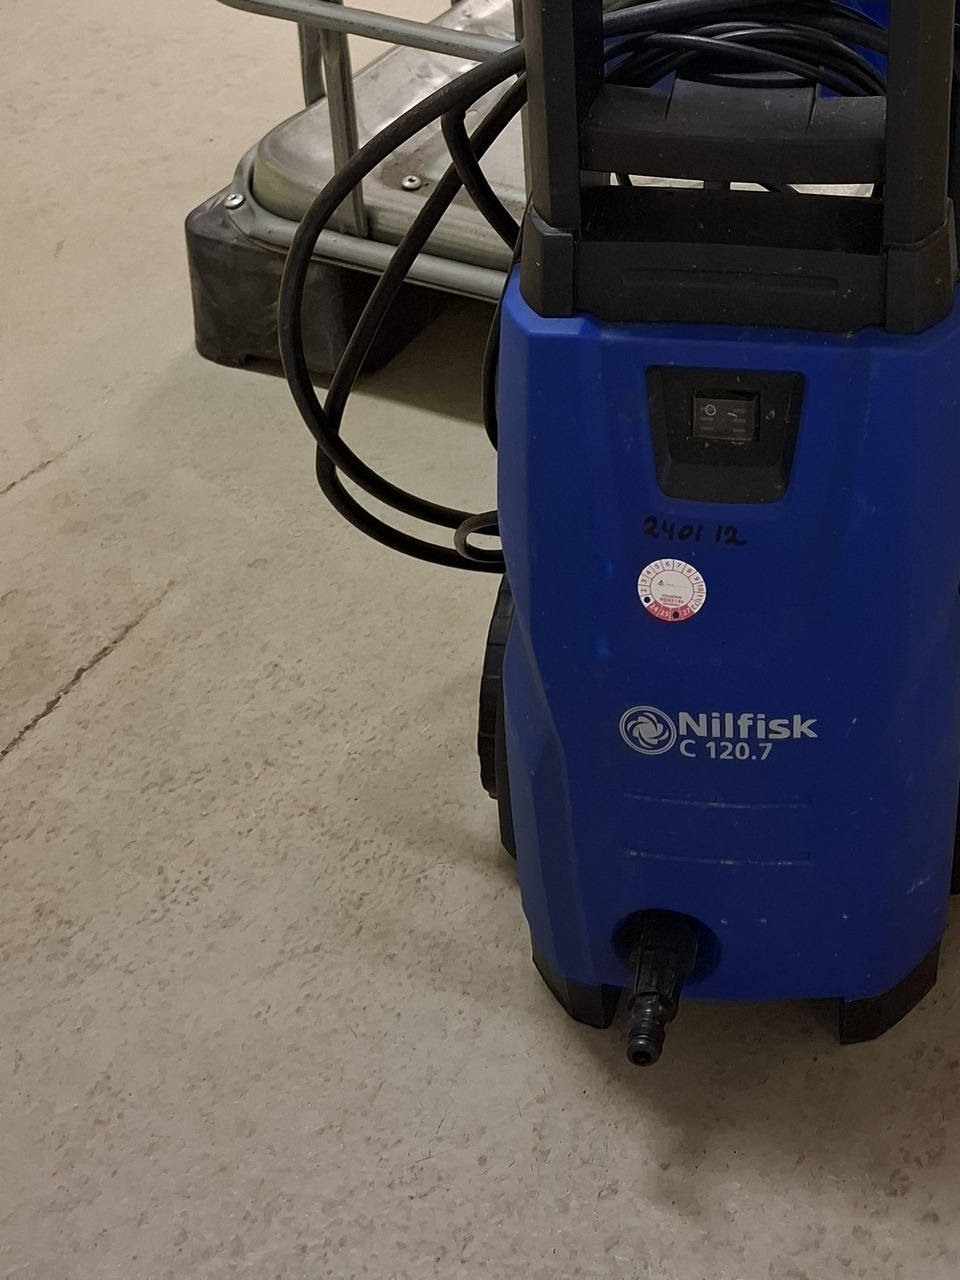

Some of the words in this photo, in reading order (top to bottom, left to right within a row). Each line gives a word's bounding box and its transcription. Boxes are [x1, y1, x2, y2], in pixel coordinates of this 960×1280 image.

[715, 524, 748, 546] 12
[697, 583, 705, 592] 10
[659, 610, 669, 618] 25
[682, 607, 690, 616] 27
[678, 711, 819, 740] Nilfisk
[679, 739, 697, 758] C
[705, 740, 773, 761] 120.7
